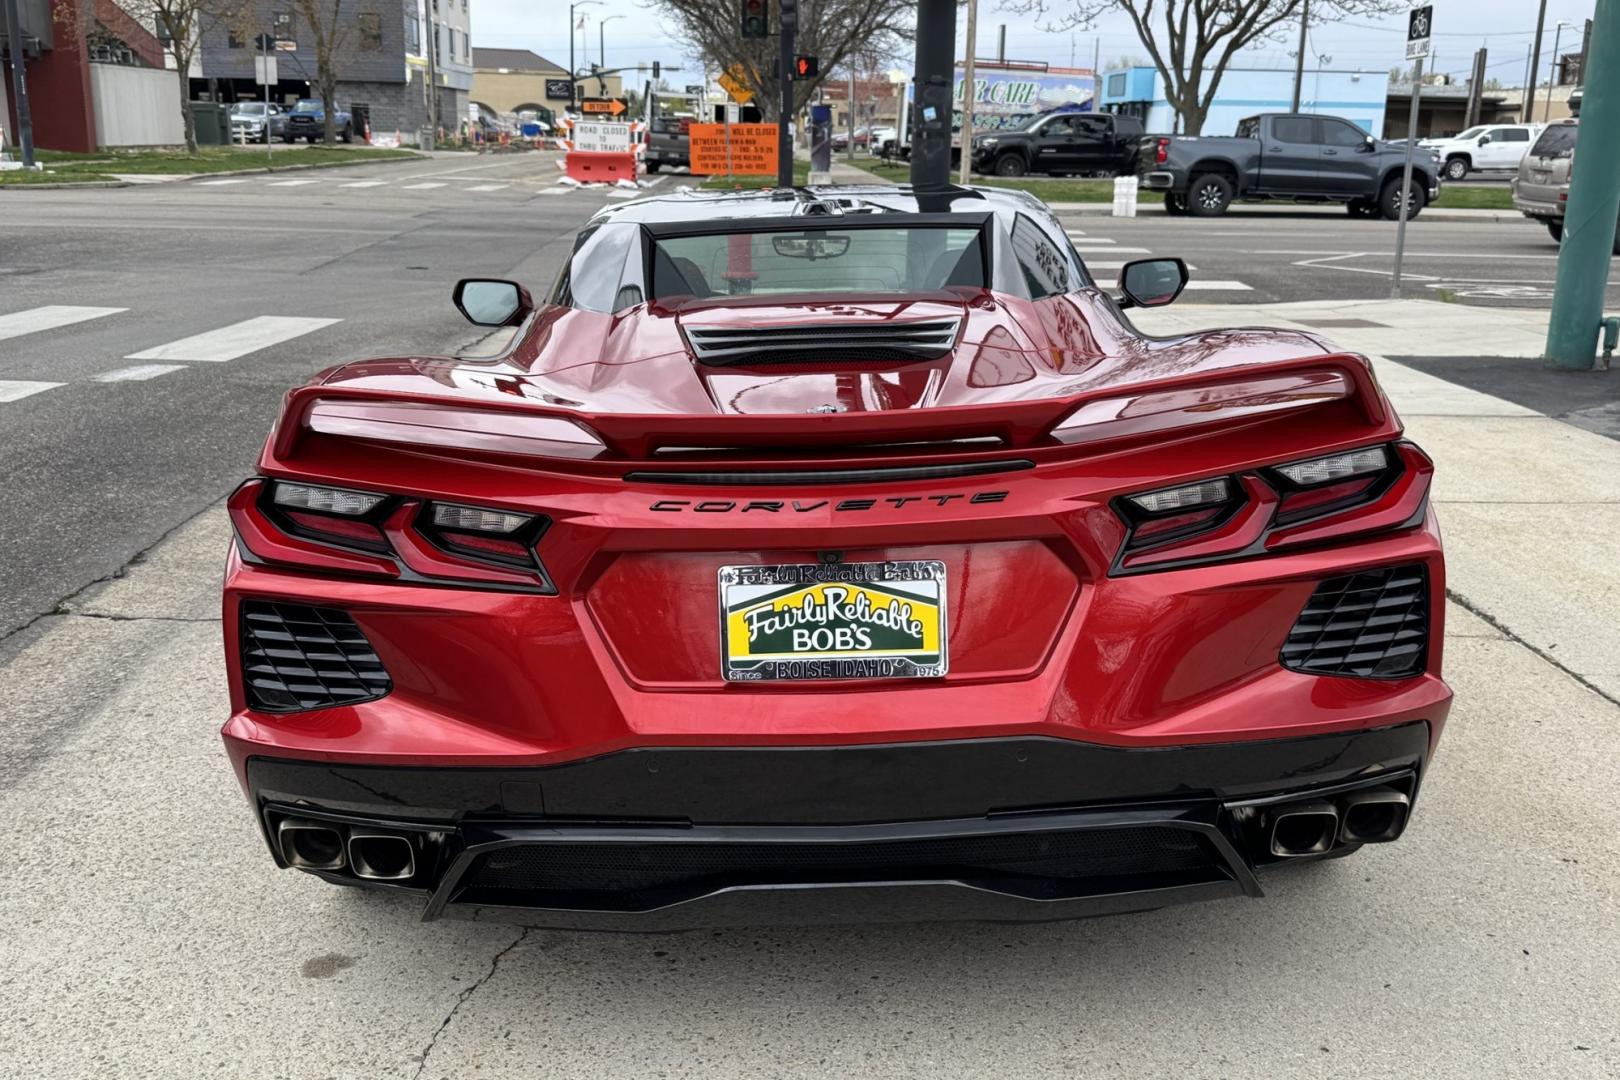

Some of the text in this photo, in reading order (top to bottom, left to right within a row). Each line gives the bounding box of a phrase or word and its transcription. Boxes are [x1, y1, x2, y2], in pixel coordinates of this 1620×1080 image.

[989, 80, 1041, 105] CARE
[588, 103, 610, 111] DETOUR
[580, 126, 627, 135] ROAD CLOSED
[732, 128, 744, 136] WILL
[746, 128, 753, 136] BE
[755, 128, 776, 136] CLOSED
[600, 144, 627, 152] TRAFFIC
[649, 491, 1009, 512] CORVETTE
[744, 587, 923, 643] Fairly Reliable
[792, 625, 872, 652] BOB'S
[729, 666, 940, 681] Since 1975
[776, 658, 895, 679] BOISE IDAHO
